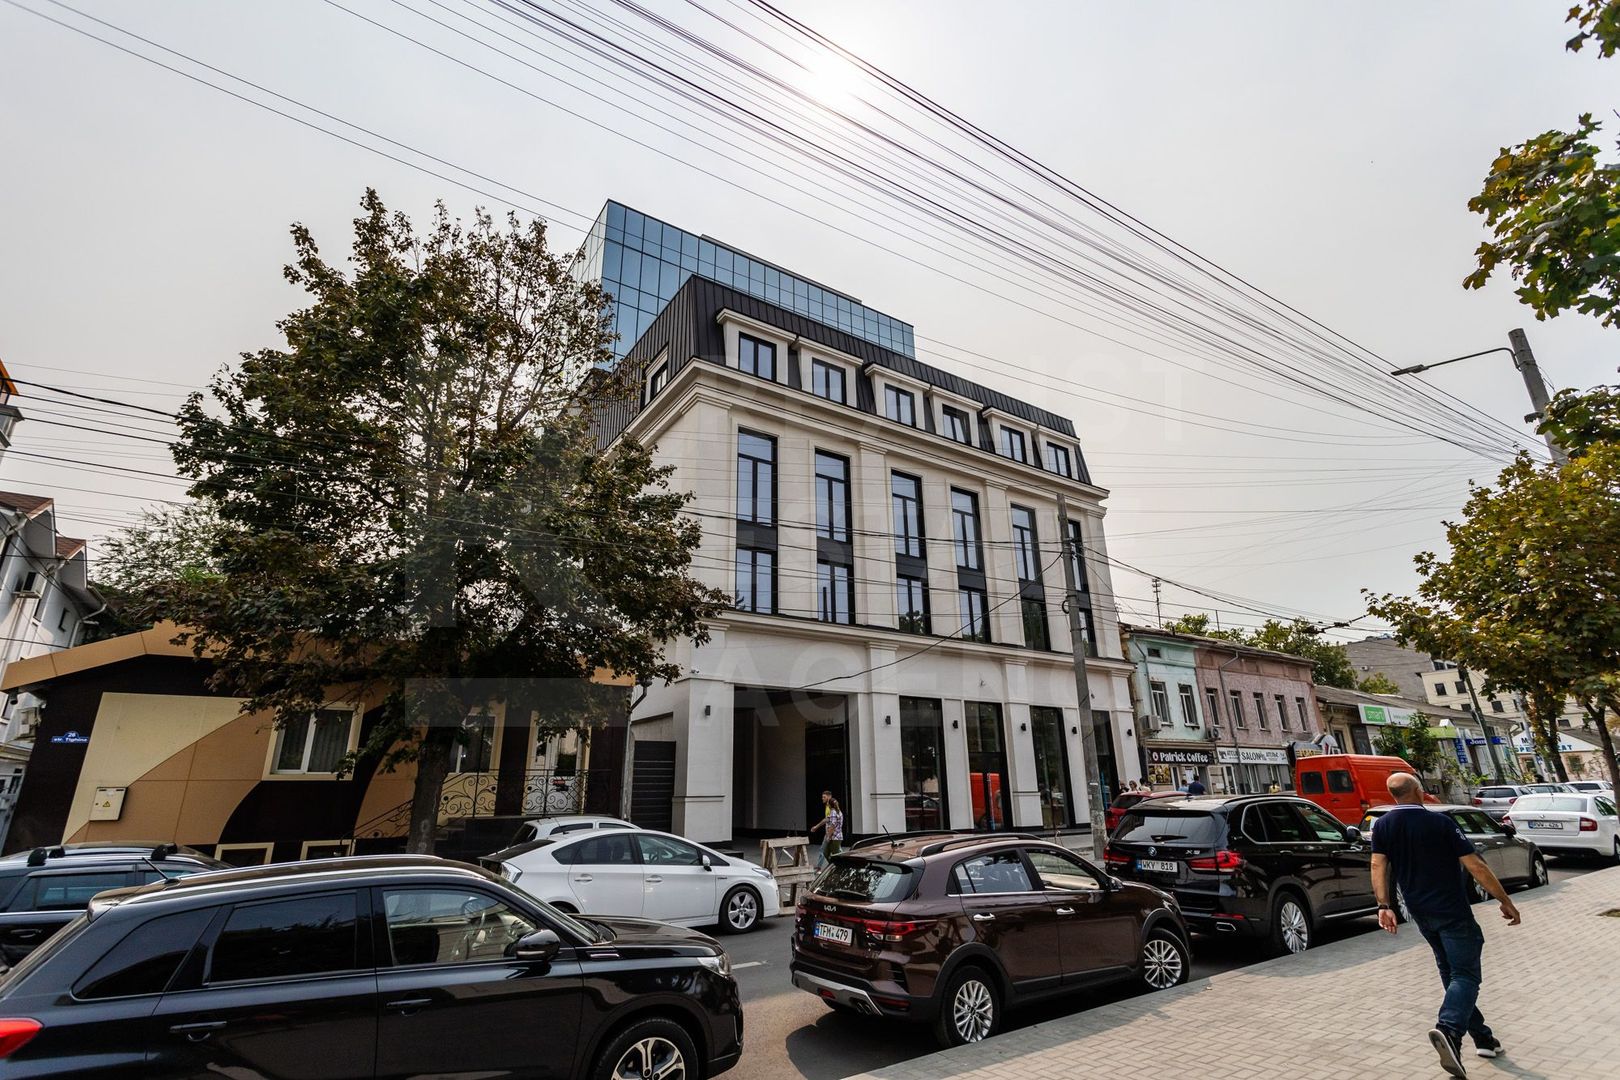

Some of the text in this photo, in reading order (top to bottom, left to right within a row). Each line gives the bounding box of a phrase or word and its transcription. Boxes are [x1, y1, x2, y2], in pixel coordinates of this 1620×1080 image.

[1160, 752, 1208, 762] Patrick Coffee
[1242, 752, 1260, 761] SALON
[1161, 863, 1173, 871] 818
[820, 925, 832, 937] TFM
[836, 929, 848, 941] 479
